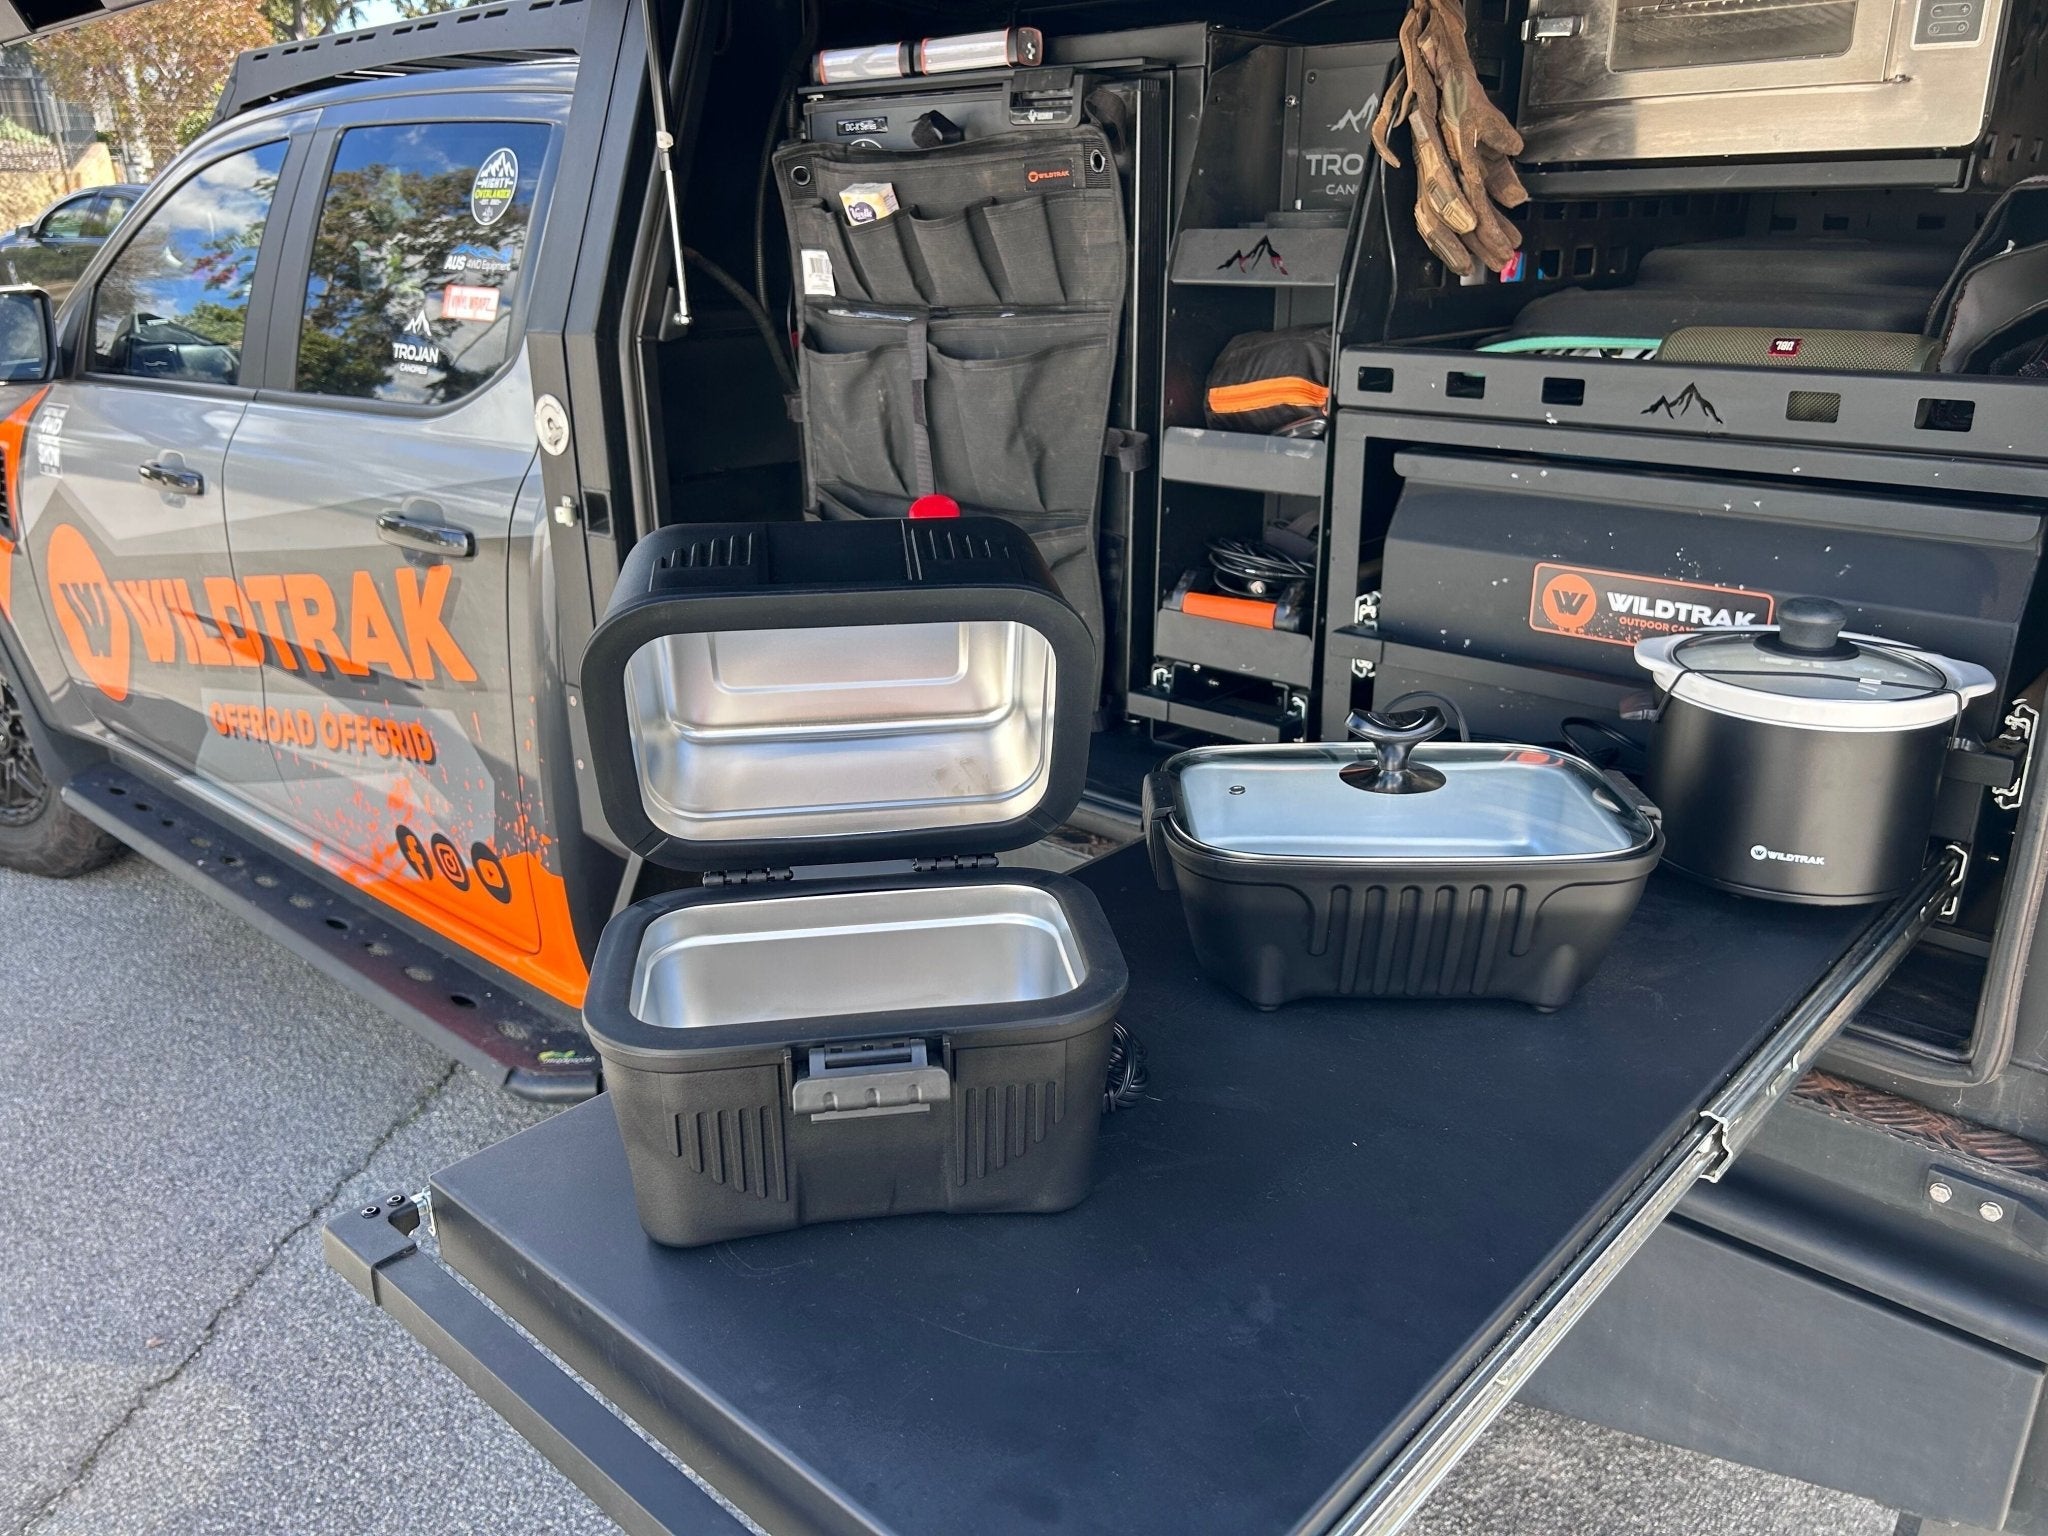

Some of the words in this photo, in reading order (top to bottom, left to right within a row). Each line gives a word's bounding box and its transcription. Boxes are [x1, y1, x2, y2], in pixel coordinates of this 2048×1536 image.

[480, 177, 511, 189] MIGHTY
[1038, 170, 1070, 179] WILDTRAK
[443, 254, 467, 271] AUS
[392, 341, 439, 364] TROJAN
[1775, 340, 1795, 352] JBL
[1606, 591, 1756, 627] WILDTRAK
[113, 564, 477, 682] WILDTRAK
[1618, 616, 1670, 633] OUTDOOR
[208, 702, 315, 748] OFFROAD
[319, 707, 434, 763] OFFGRID
[1767, 850, 1825, 866] WILDTRAK
